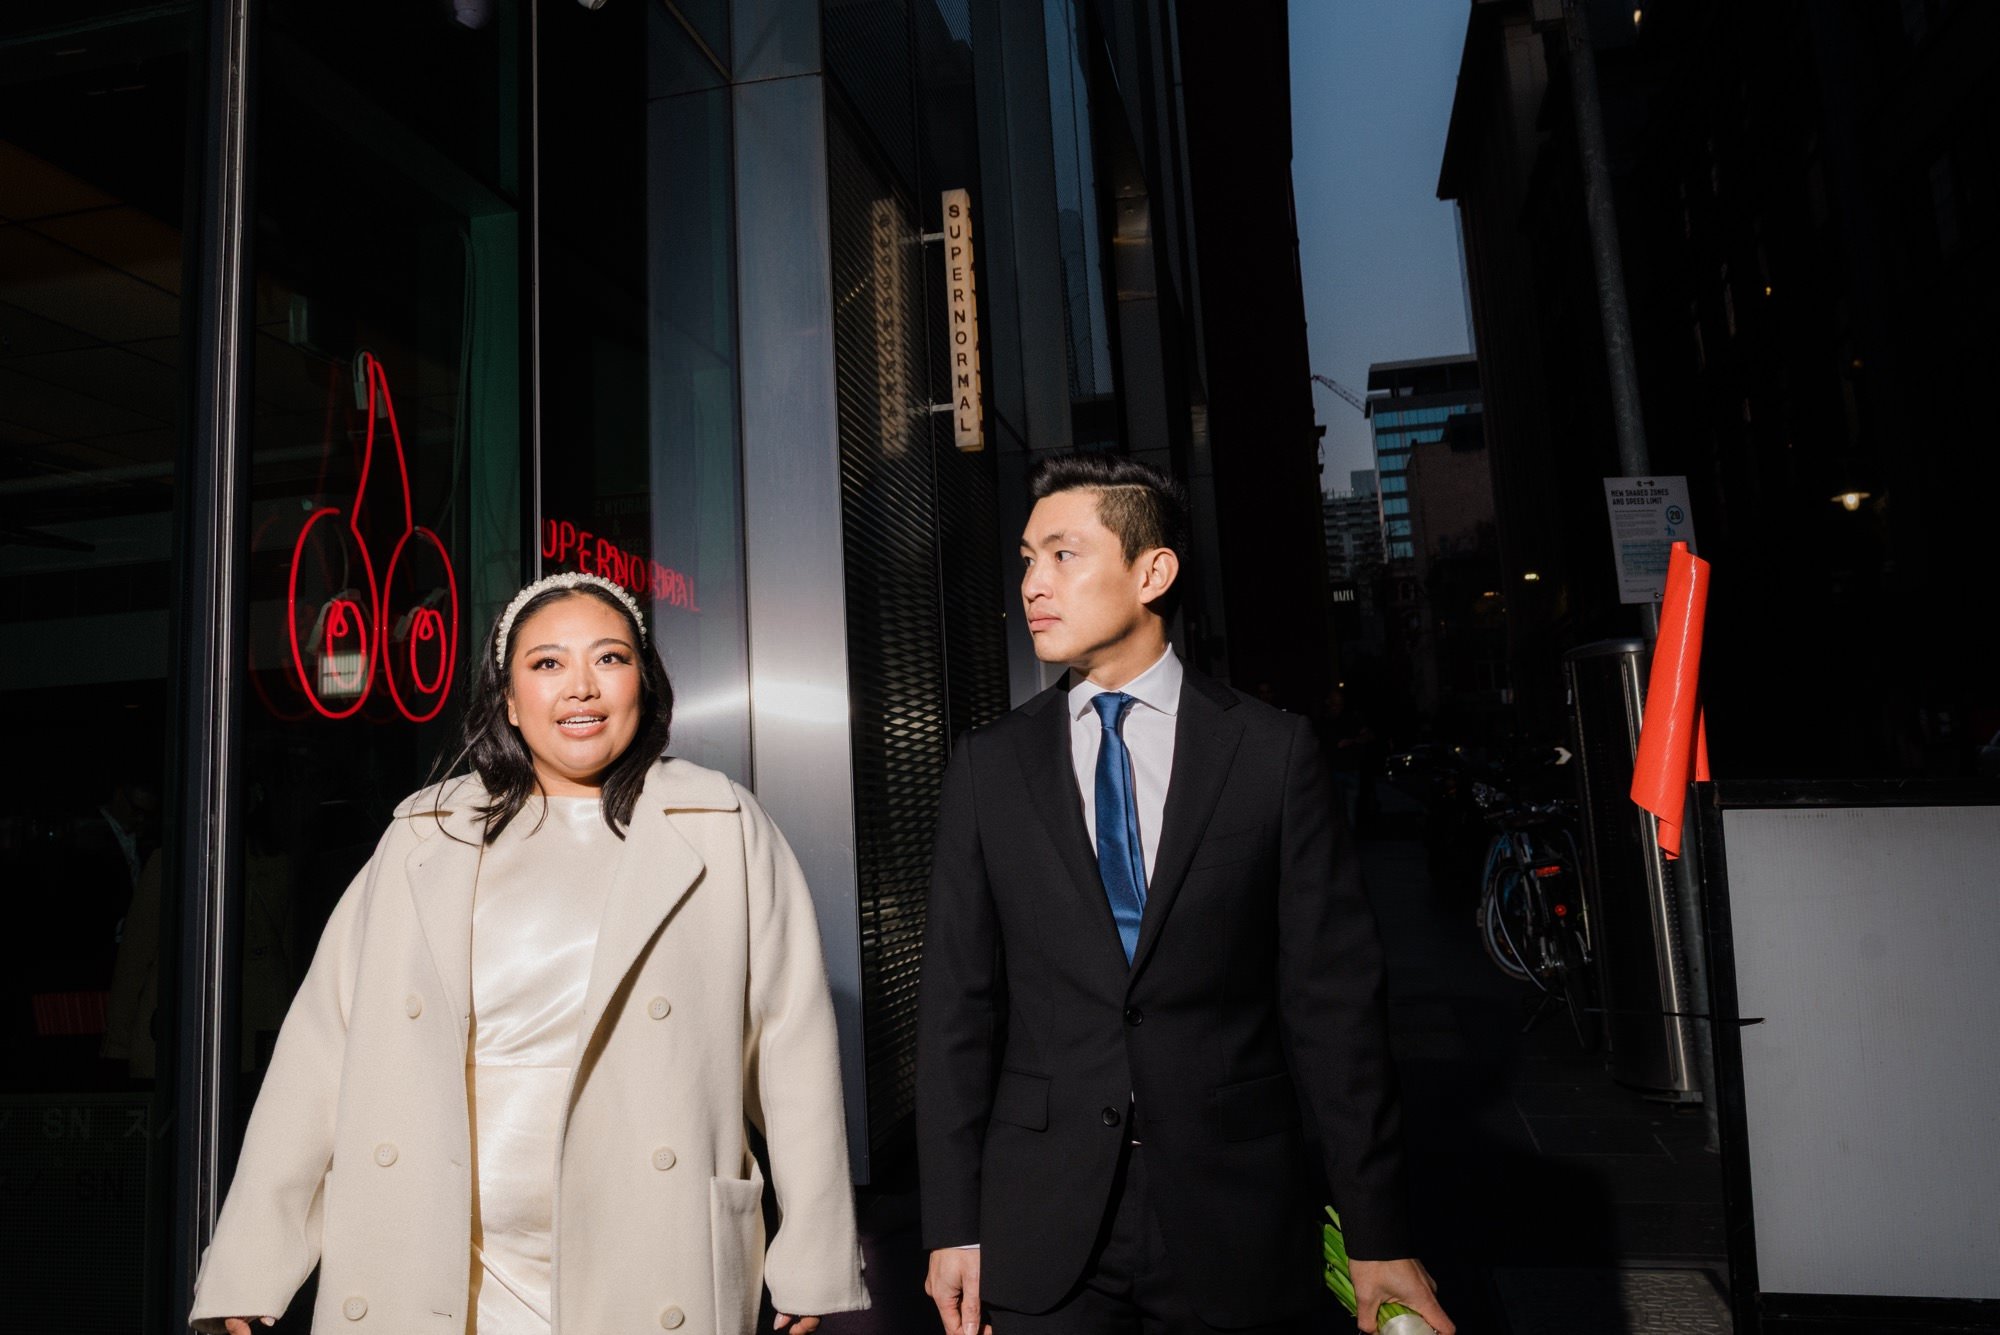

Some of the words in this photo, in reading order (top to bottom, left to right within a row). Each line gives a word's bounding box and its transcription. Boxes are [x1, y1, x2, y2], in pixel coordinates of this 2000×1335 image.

[948, 204, 972, 432] SUPERNORMAL
[1650, 488, 1669, 496] ZONES
[1626, 497, 1645, 505] SPEED
[1669, 510, 1681, 520] 20
